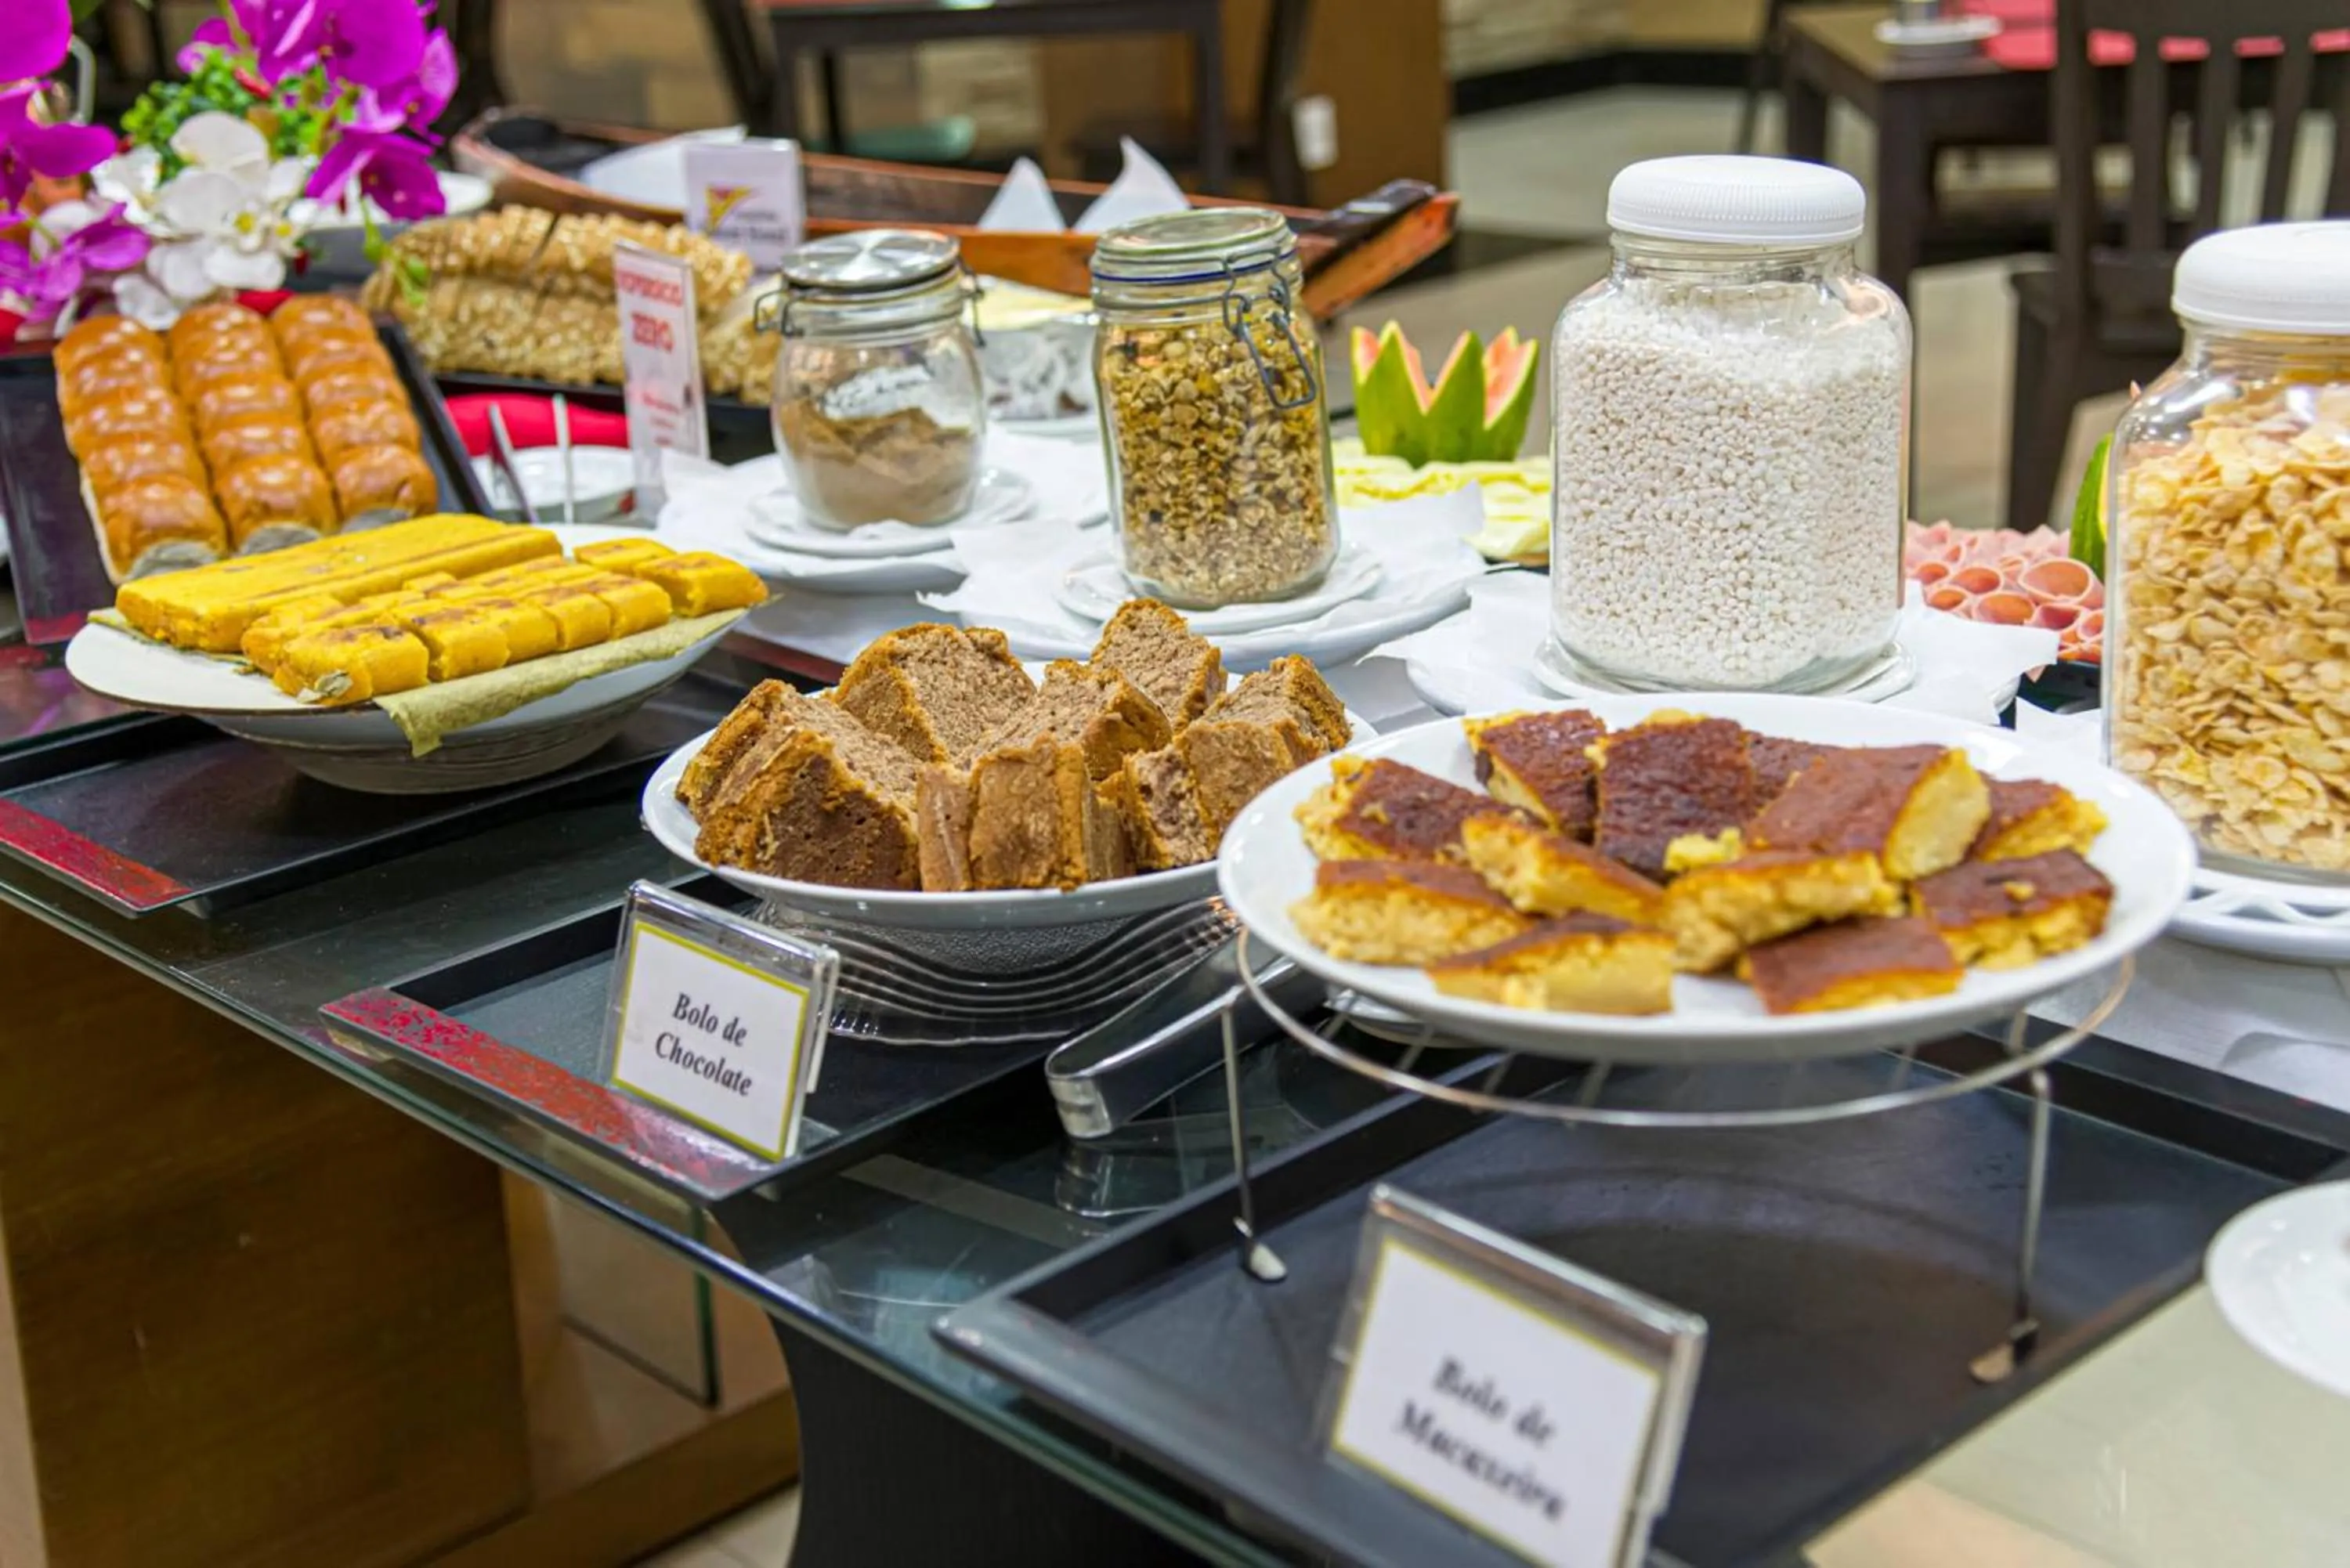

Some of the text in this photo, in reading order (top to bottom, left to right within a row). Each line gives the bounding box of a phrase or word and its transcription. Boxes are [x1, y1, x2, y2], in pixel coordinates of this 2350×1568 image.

[672, 993, 747, 1047] Bolo de
[655, 1032, 753, 1097] Chocolate
[1432, 1356, 1555, 1447] Bolo de
